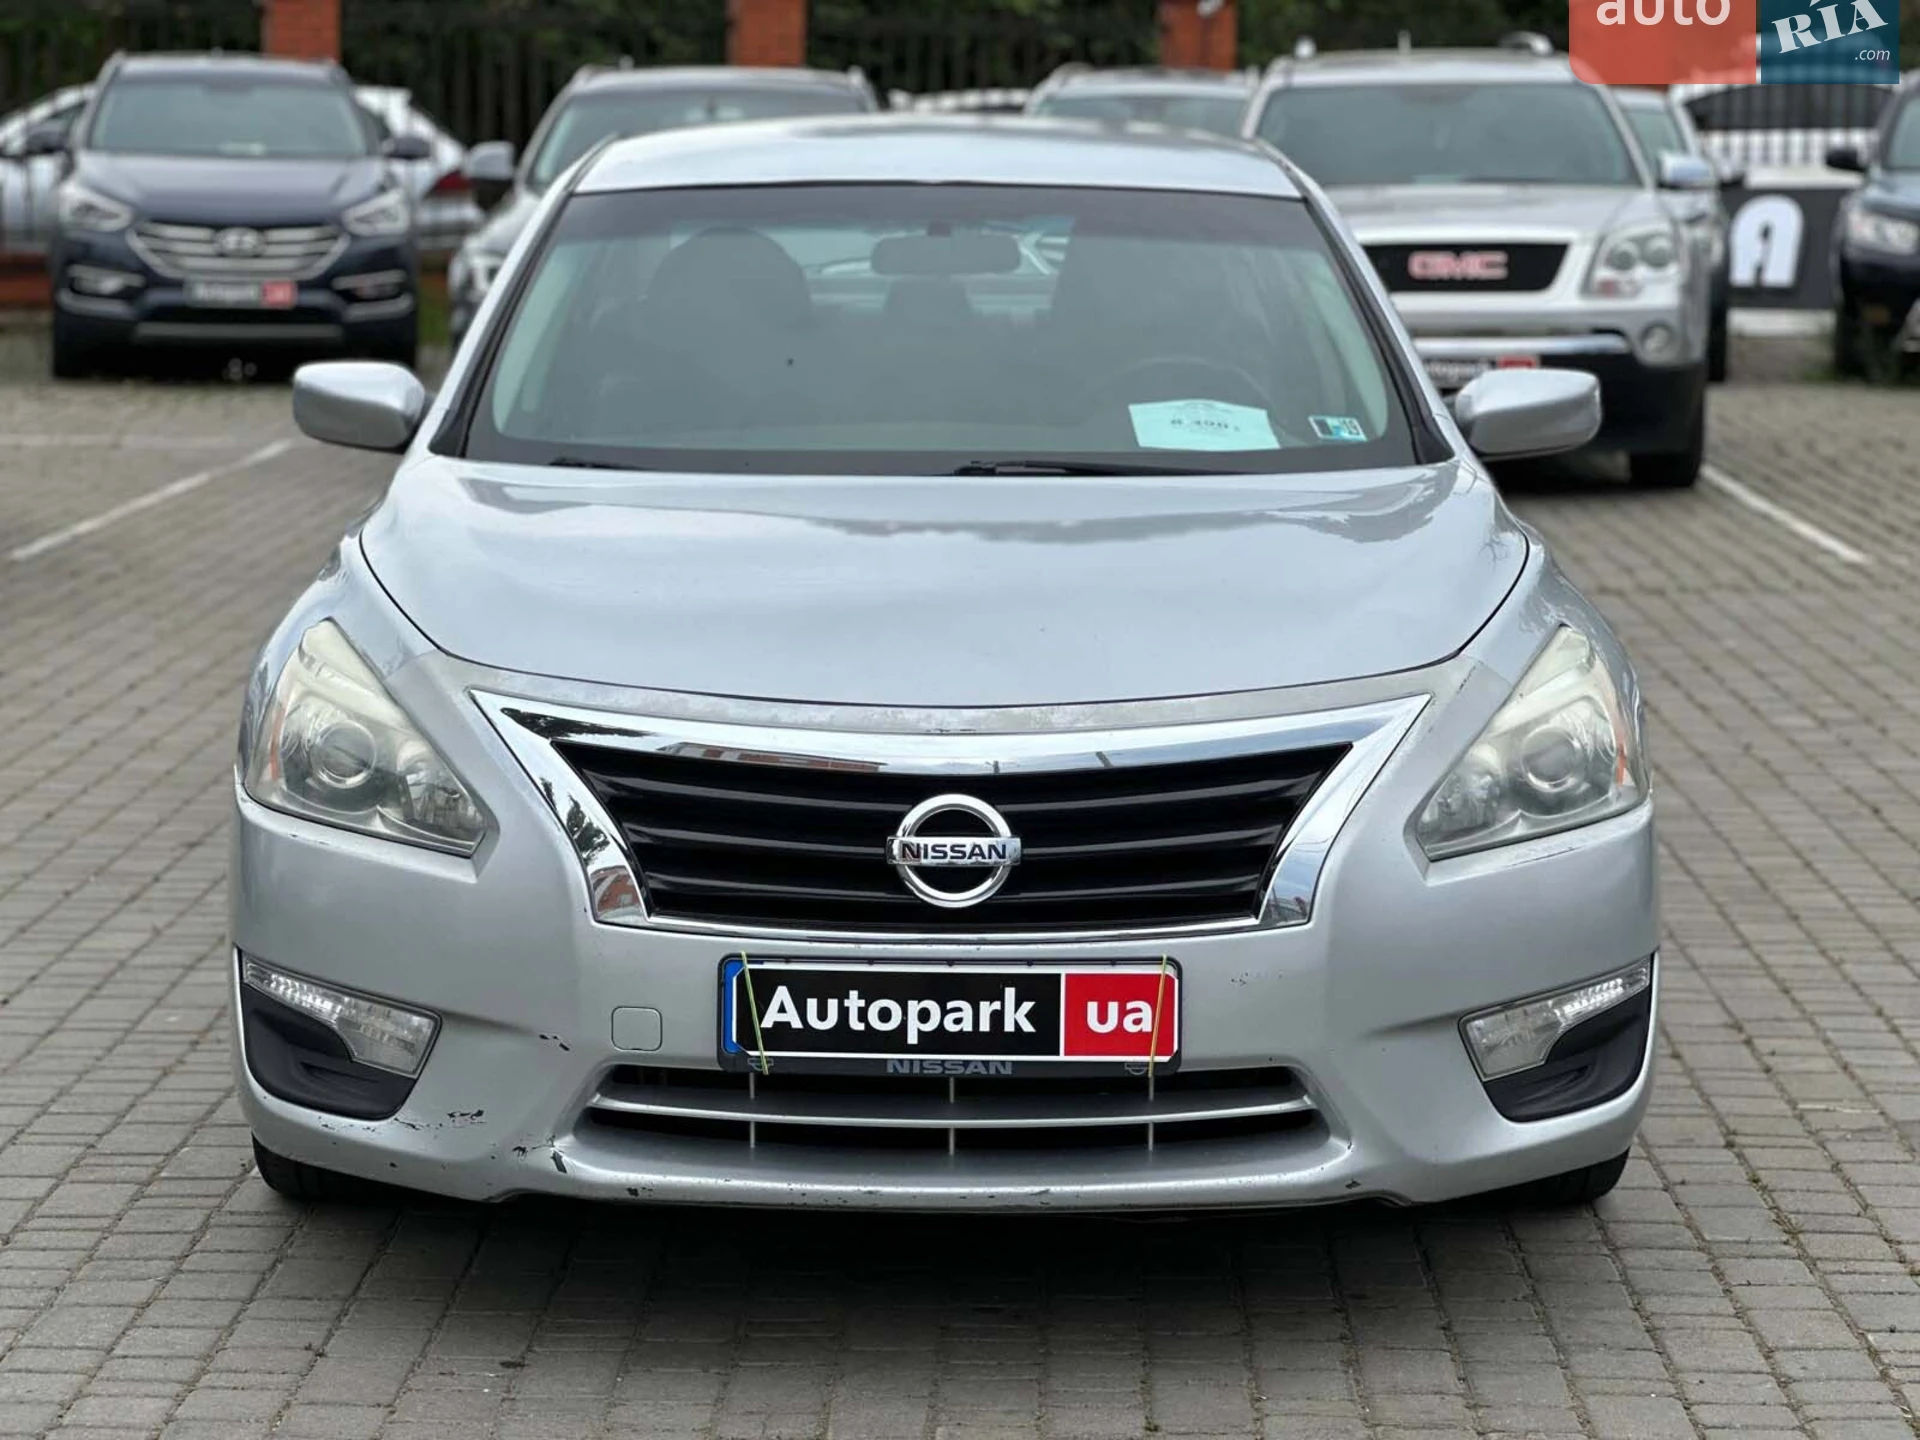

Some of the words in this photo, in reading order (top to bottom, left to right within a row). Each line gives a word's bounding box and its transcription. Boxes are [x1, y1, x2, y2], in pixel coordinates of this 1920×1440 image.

[1407, 250, 1508, 280] GMC
[902, 843, 1006, 860] NISSAN
[760, 985, 1037, 1045] Autopark
[1086, 999, 1153, 1034] ua
[886, 1059, 1013, 1077] NISSAN
